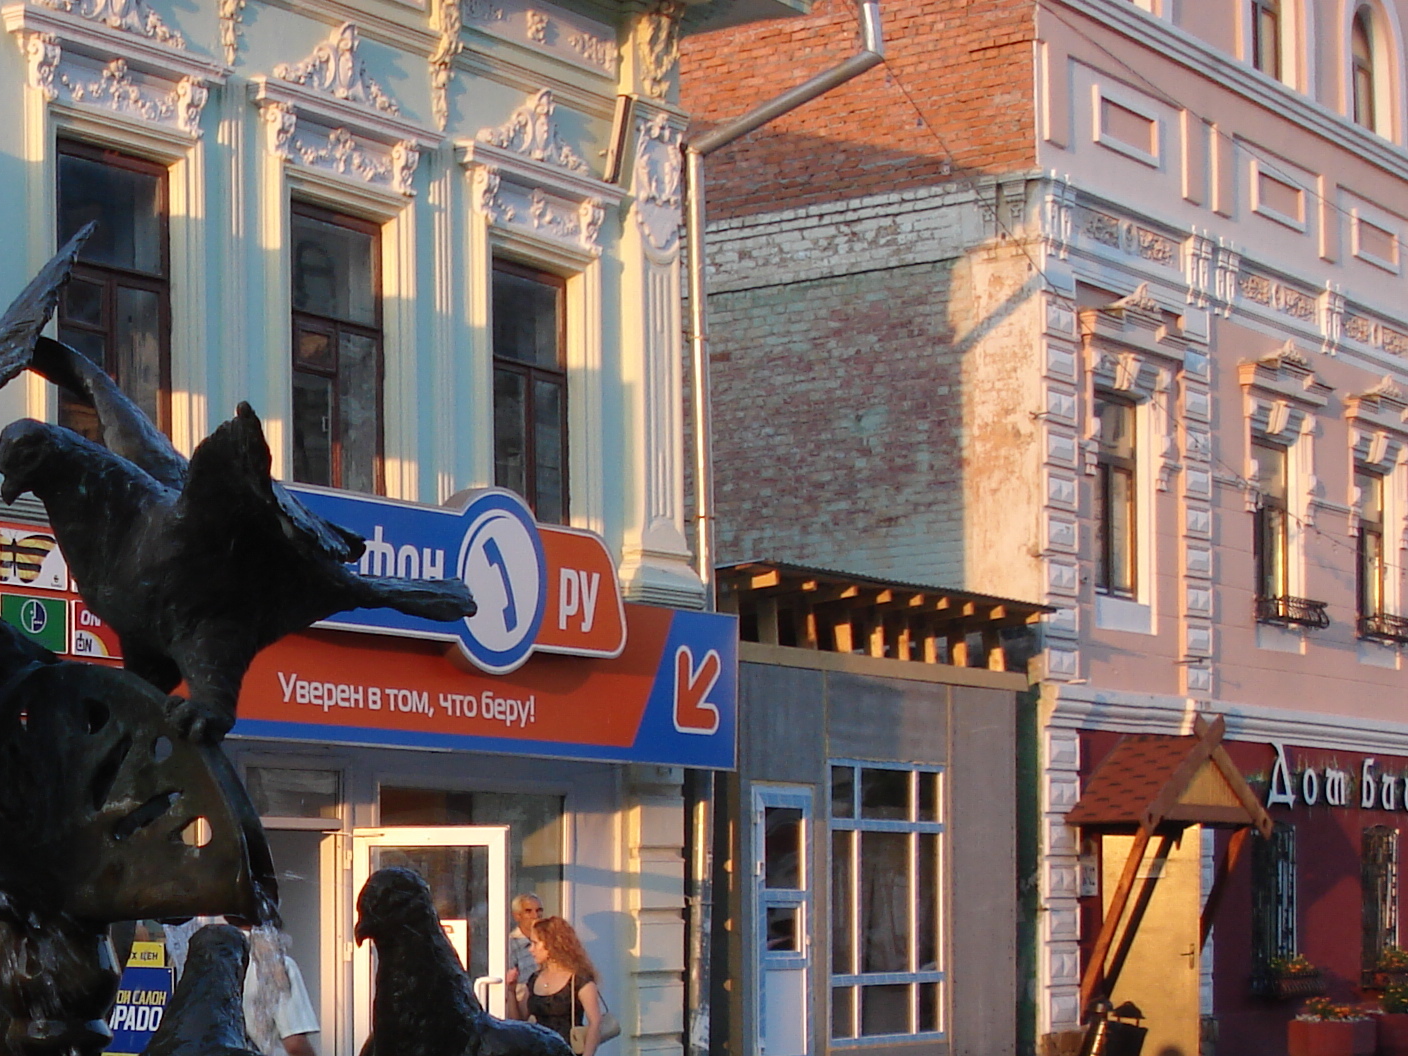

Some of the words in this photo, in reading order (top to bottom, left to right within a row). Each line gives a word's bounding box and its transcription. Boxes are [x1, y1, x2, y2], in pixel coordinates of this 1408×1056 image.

[344, 525, 445, 580] фон
[277, 671, 364, 713] Уверен
[368, 686, 382, 710] в
[385, 688, 435, 718] том,
[439, 692, 478, 717] что
[481, 691, 536, 728] беру!
[132, 990, 167, 1006] САЛОН
